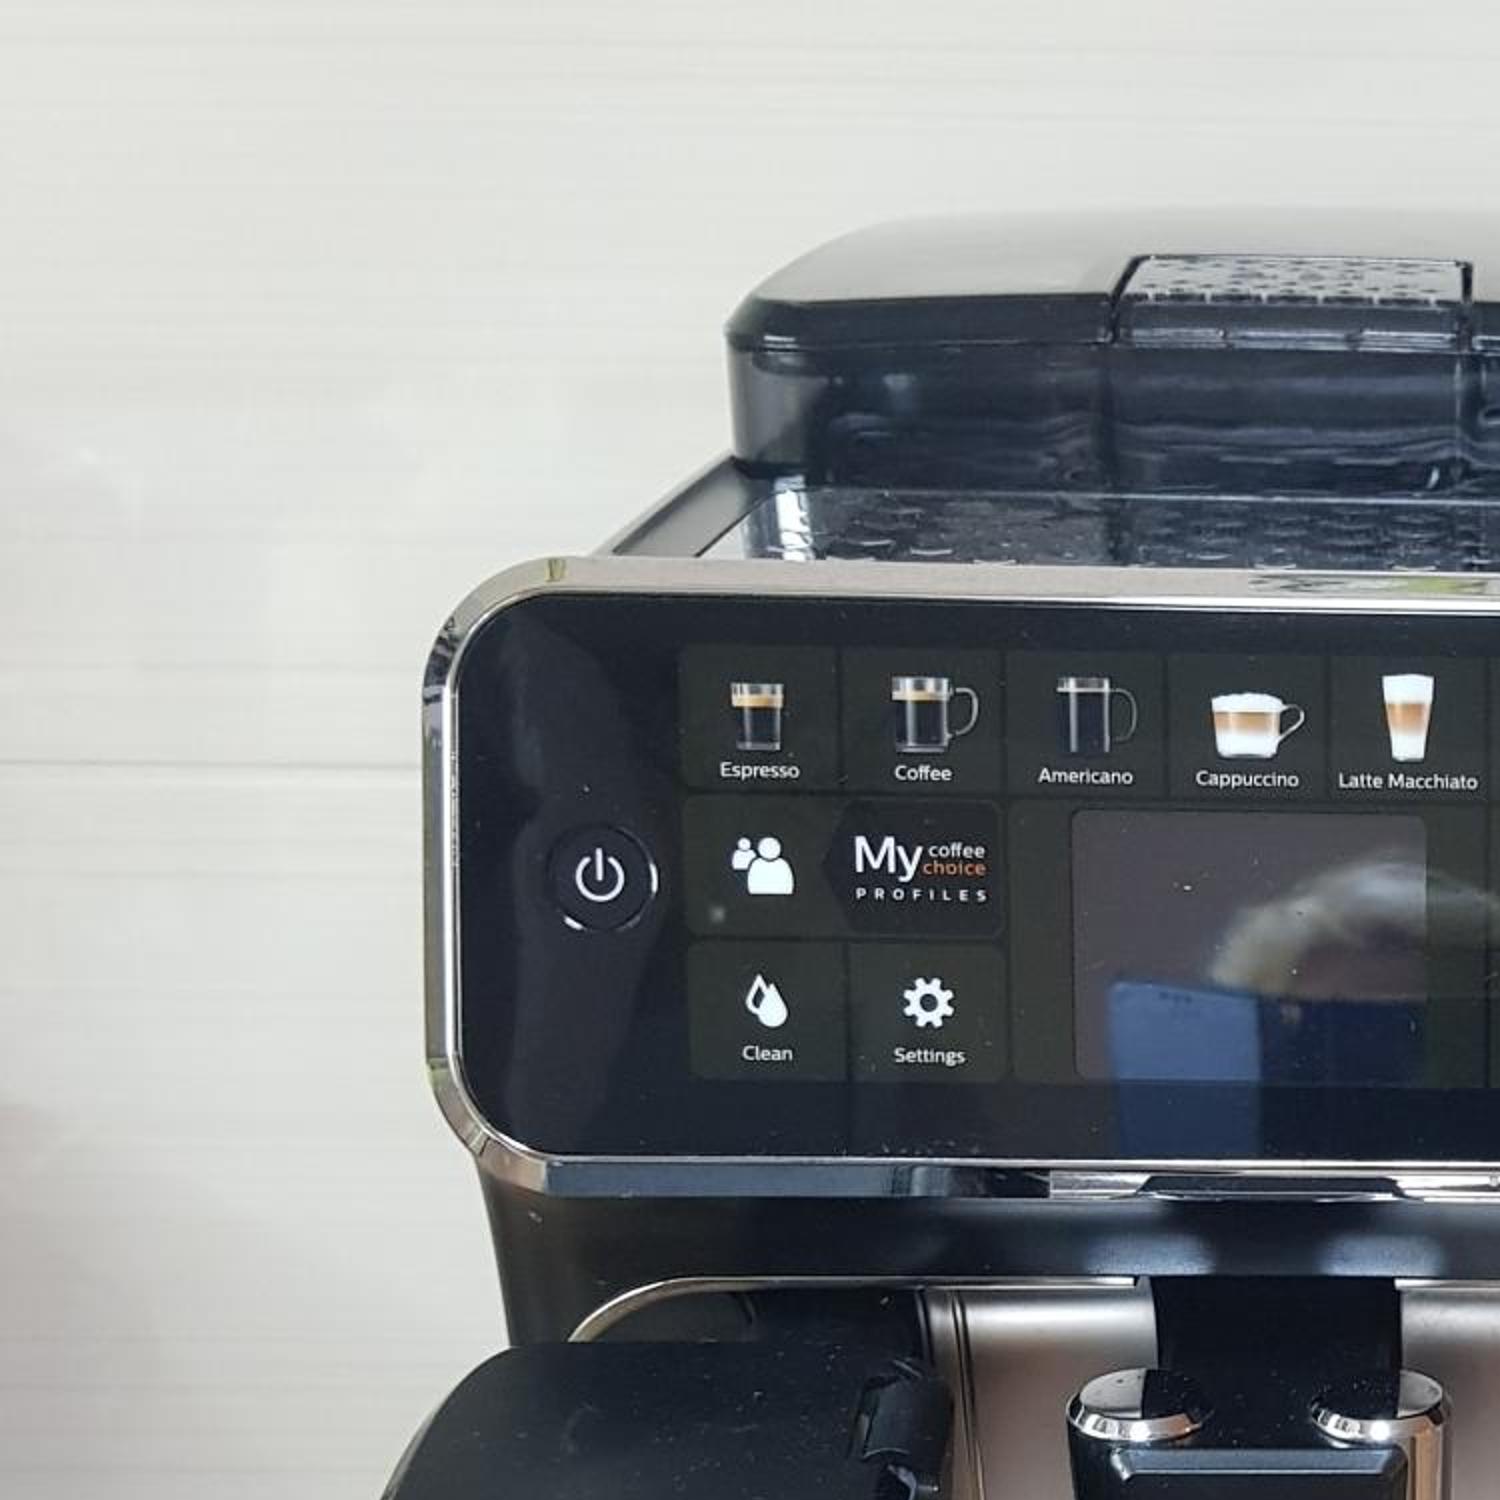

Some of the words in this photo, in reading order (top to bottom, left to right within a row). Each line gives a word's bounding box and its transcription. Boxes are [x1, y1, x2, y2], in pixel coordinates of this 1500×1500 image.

[720, 762, 800, 780] Espresso
[895, 765, 952, 780] Coffee
[1039, 768, 1133, 784] Americano
[1196, 770, 1299, 788] Cappuccino
[1339, 773, 1383, 788] Latte
[1389, 773, 1478, 789] Macchiato
[855, 836, 922, 882] My
[928, 842, 985, 858] coffee
[923, 859, 986, 875] choice
[856, 888, 986, 901] PROFILES
[742, 1045, 792, 1060] Clean
[894, 1048, 965, 1066] Settings
